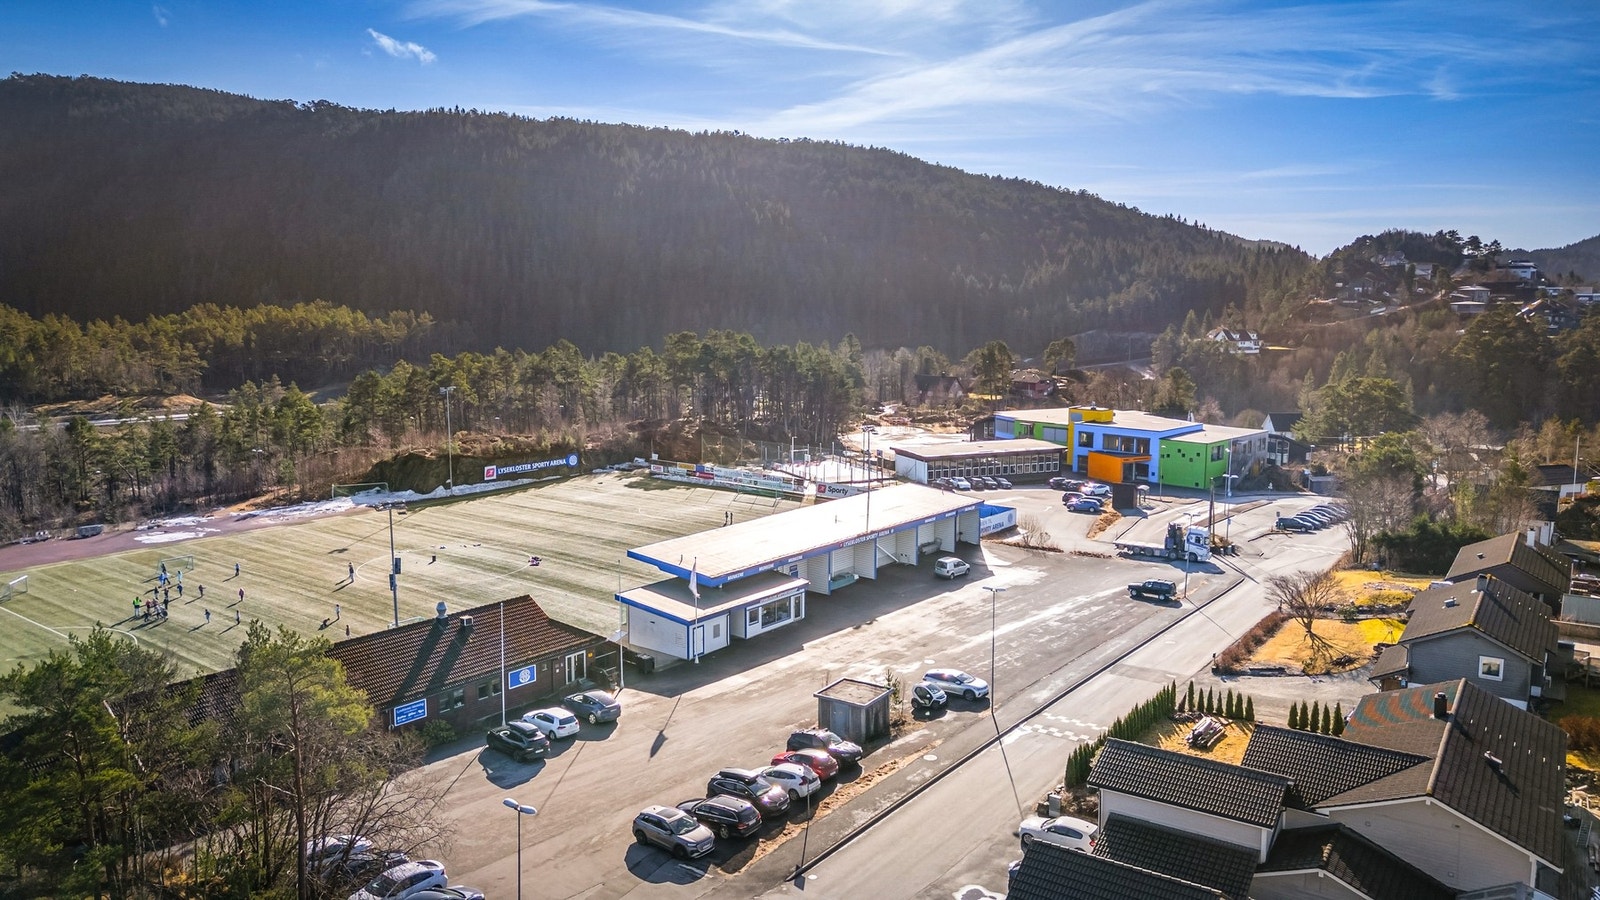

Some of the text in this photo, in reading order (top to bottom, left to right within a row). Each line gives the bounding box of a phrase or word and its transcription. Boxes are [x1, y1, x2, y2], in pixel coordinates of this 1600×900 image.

[498, 458, 566, 474] LYSEKLOSTER SPORTY ARENA
[828, 486, 848, 495] Sporty
